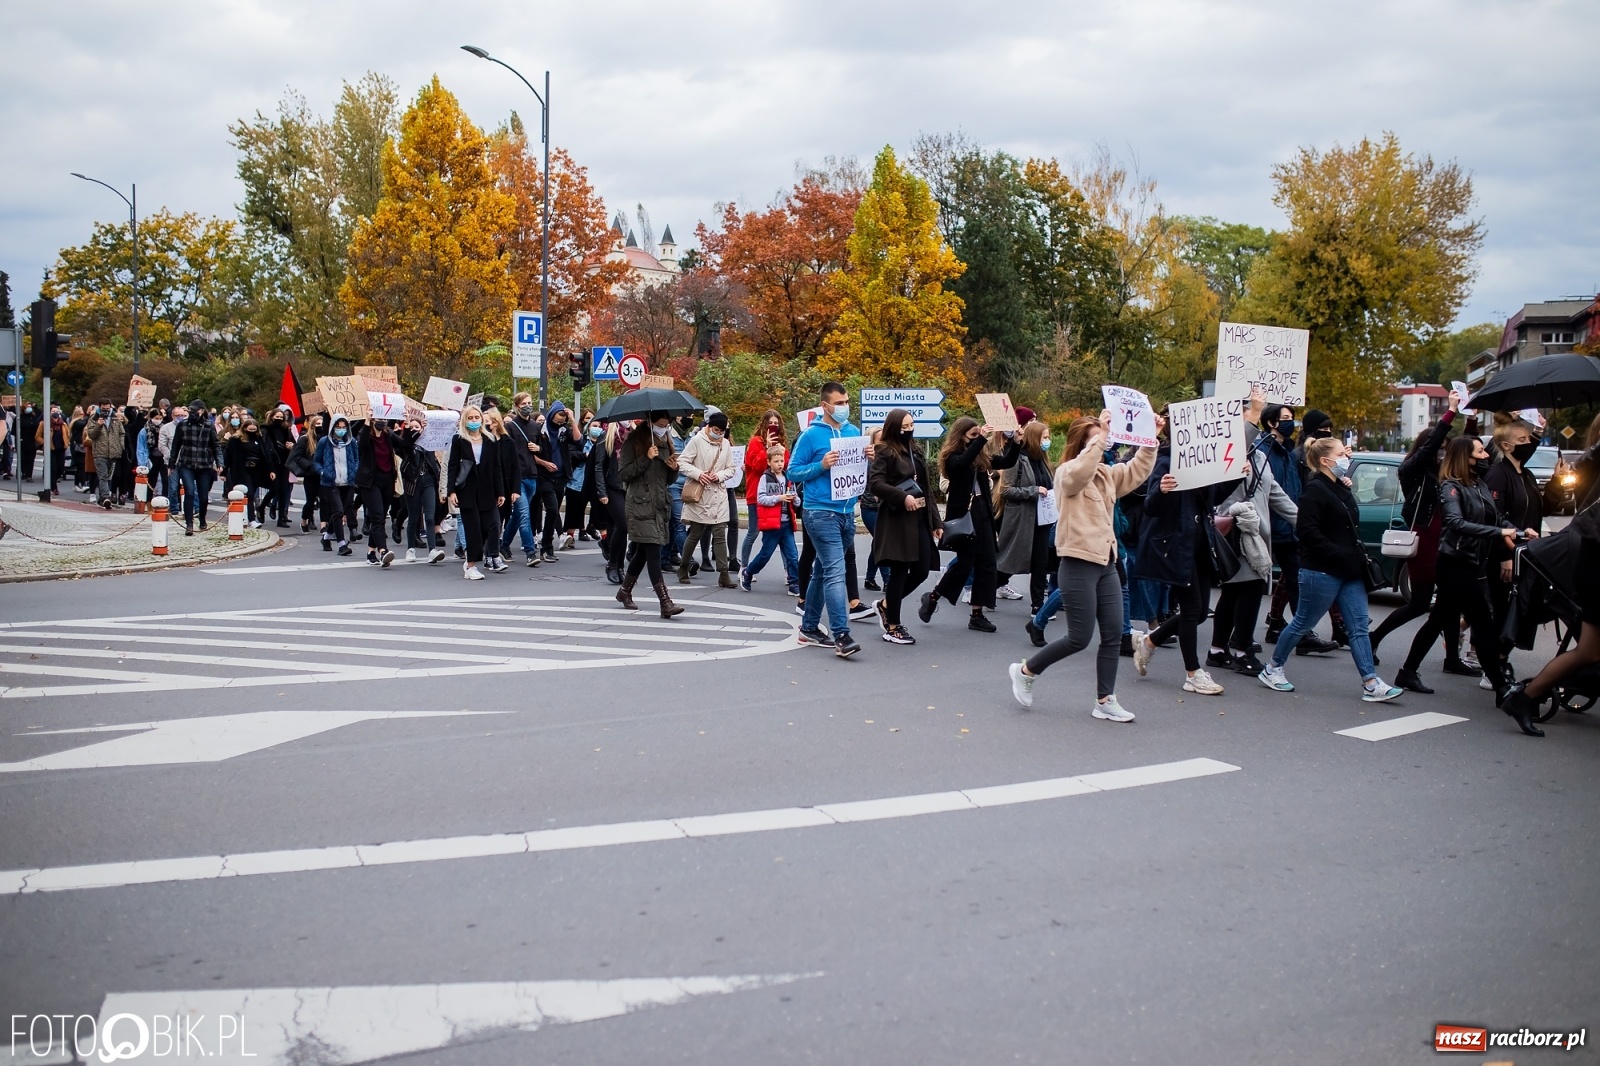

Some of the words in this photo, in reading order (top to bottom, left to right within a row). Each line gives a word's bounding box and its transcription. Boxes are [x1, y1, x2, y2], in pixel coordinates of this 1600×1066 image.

[524, 320, 536, 340] P
[1224, 326, 1256, 343] MARS
[1263, 330, 1275, 342] OD
[1241, 345, 1256, 356] TO
[1263, 345, 1292, 359] SRAM
[1227, 356, 1245, 369] PIS
[1253, 357, 1267, 368] OD
[324, 377, 354, 391] WARA
[1226, 368, 1254, 383] JEST
[1258, 369, 1267, 381] W
[1269, 370, 1299, 388] DUPĘ
[336, 391, 355, 404] OD
[865, 393, 890, 402] Urząd
[894, 393, 925, 401] Miasta
[1284, 396, 1301, 405] ELO
[330, 404, 367, 417] KOBIET
[865, 409, 889, 417] Dwor
[1173, 405, 1197, 426] ŁAPY
[1204, 400, 1241, 420] PRECZ
[1177, 429, 1191, 446] OD
[1196, 420, 1231, 439] MOJEJ
[1178, 442, 1217, 469] MACICY
[833, 472, 865, 489] ODDAĆ
[835, 489, 847, 499] NIE
